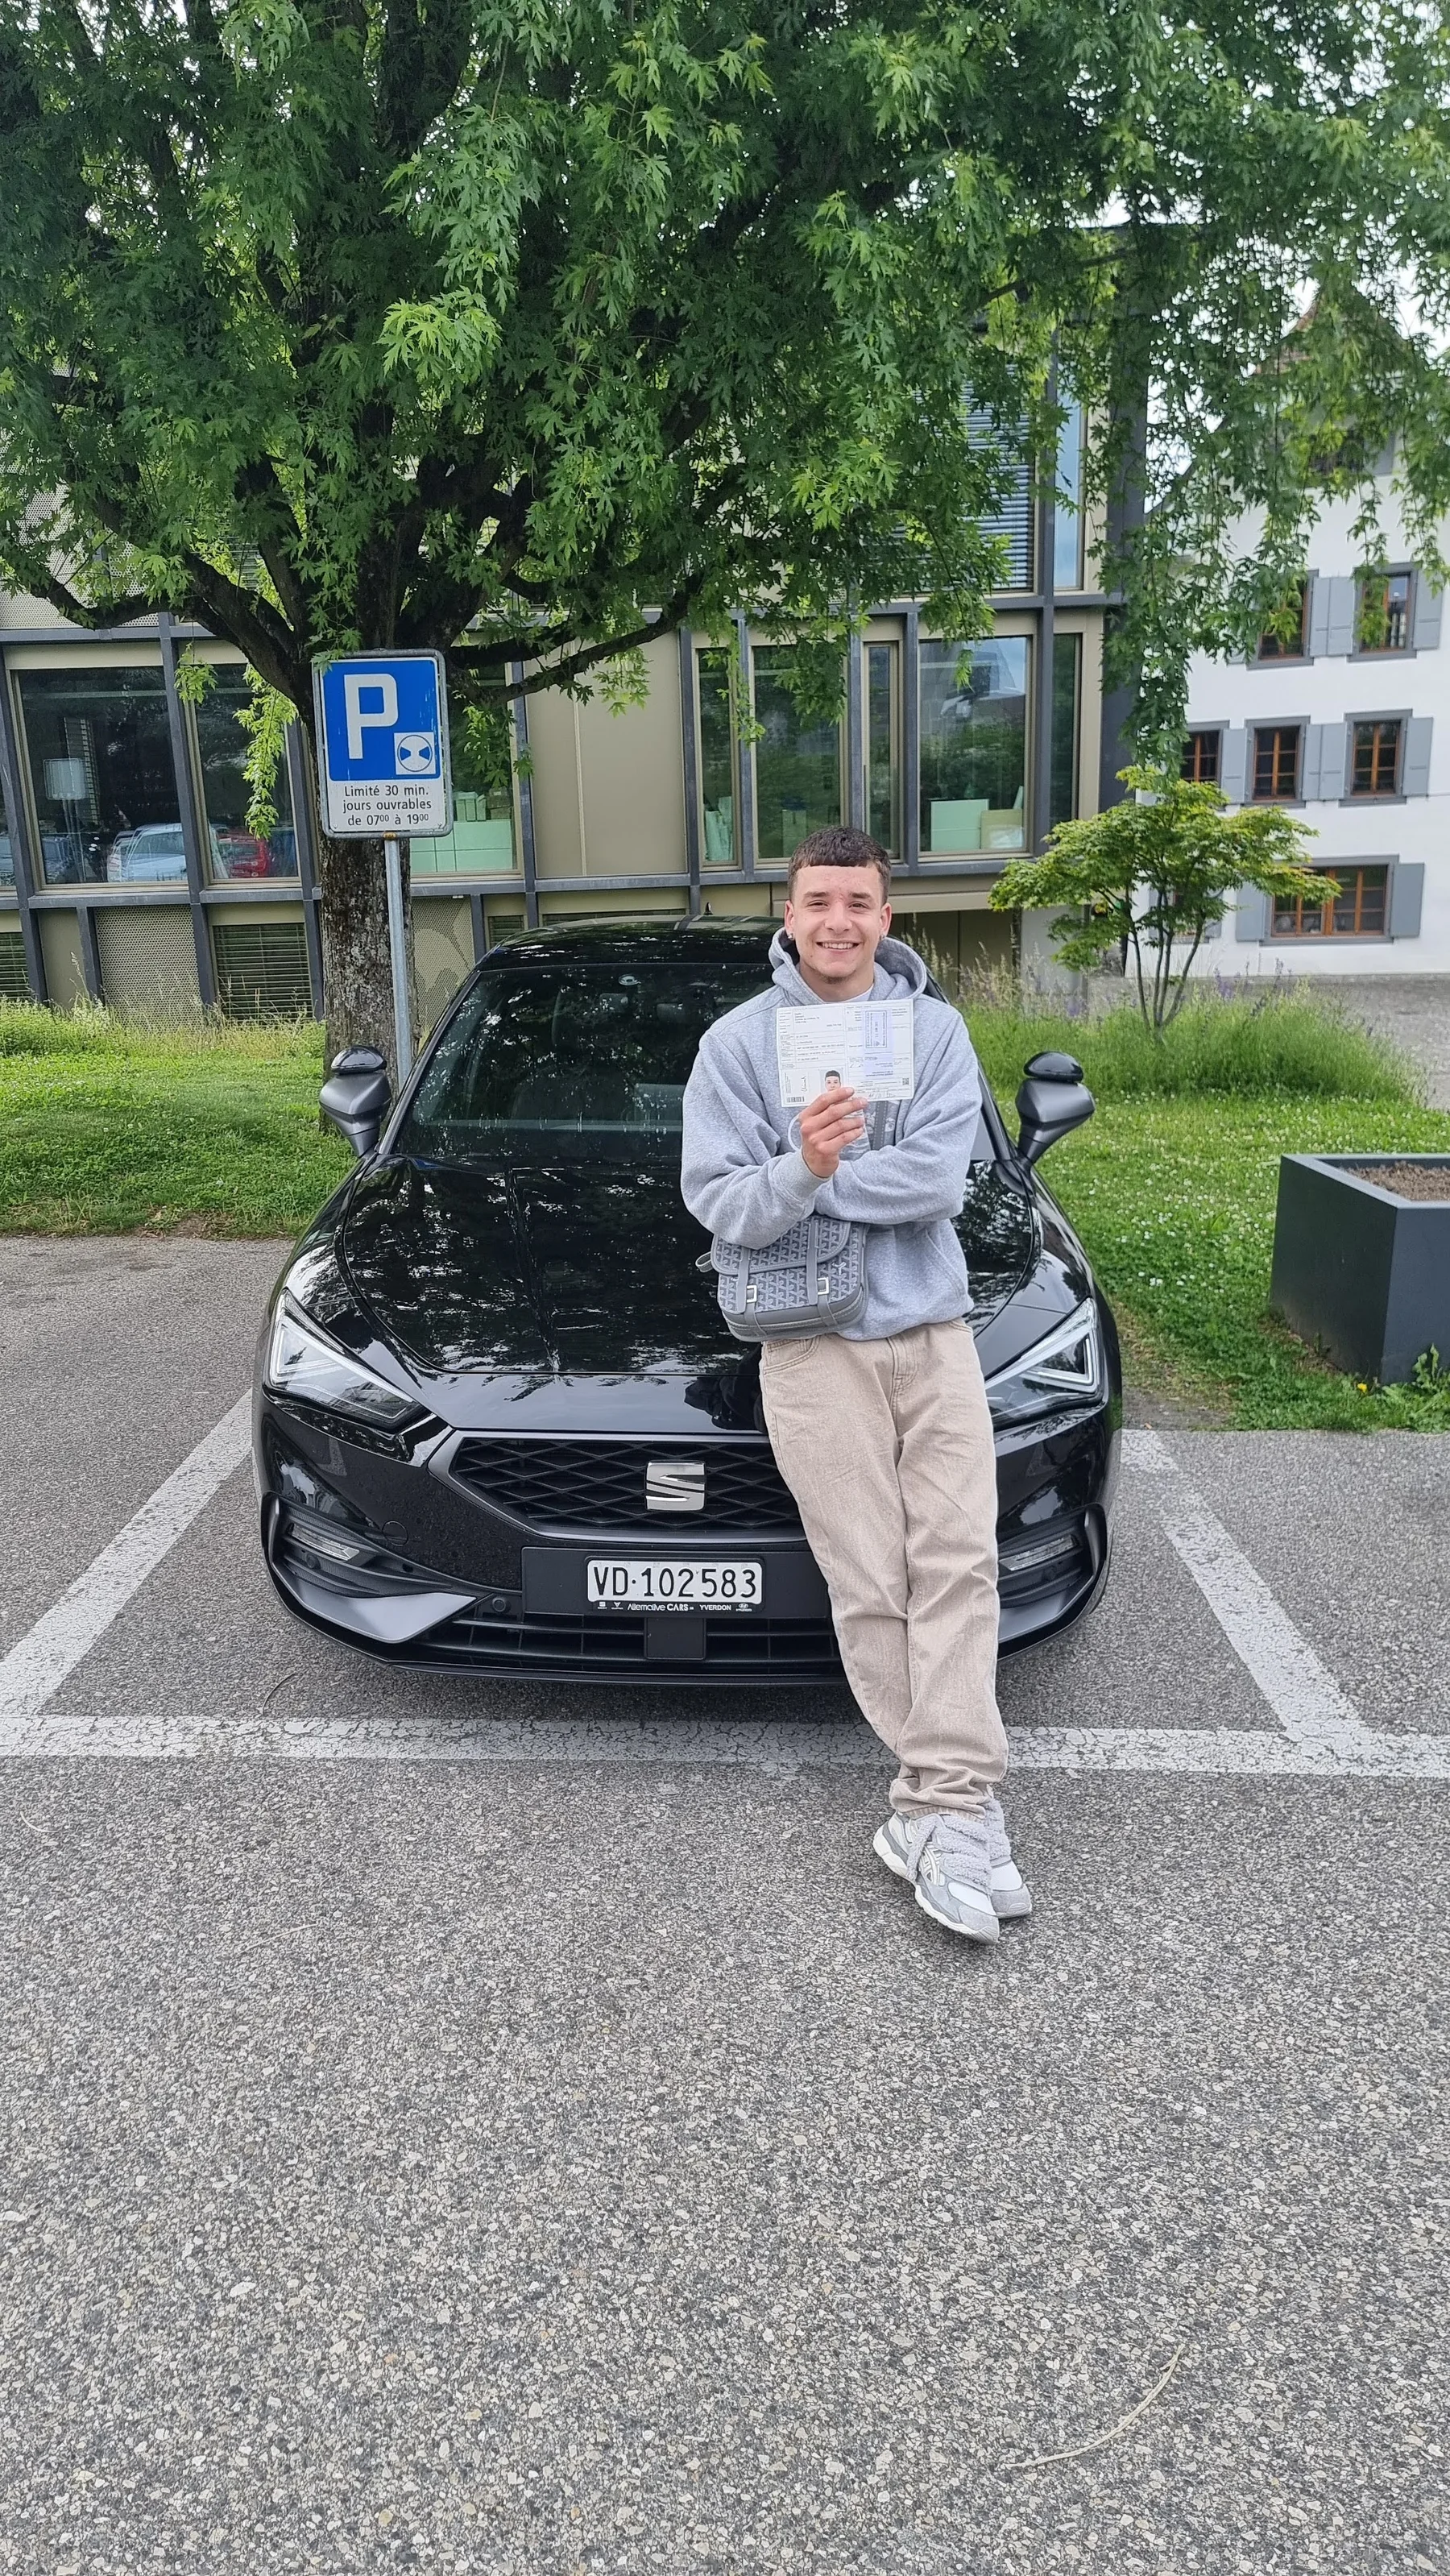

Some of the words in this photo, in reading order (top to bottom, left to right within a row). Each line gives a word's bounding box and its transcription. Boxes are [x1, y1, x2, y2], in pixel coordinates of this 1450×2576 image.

[344, 673, 399, 760] P
[344, 785, 380, 797] Limité
[384, 785, 399, 796] 30
[404, 784, 429, 796] min.
[342, 799, 371, 814] jours
[376, 798, 432, 810] ouvrables
[347, 815, 362, 826] de
[395, 814, 401, 825] à
[628, 1603, 666, 1612] Alternative
[666, 1603, 689, 1612] CARS
